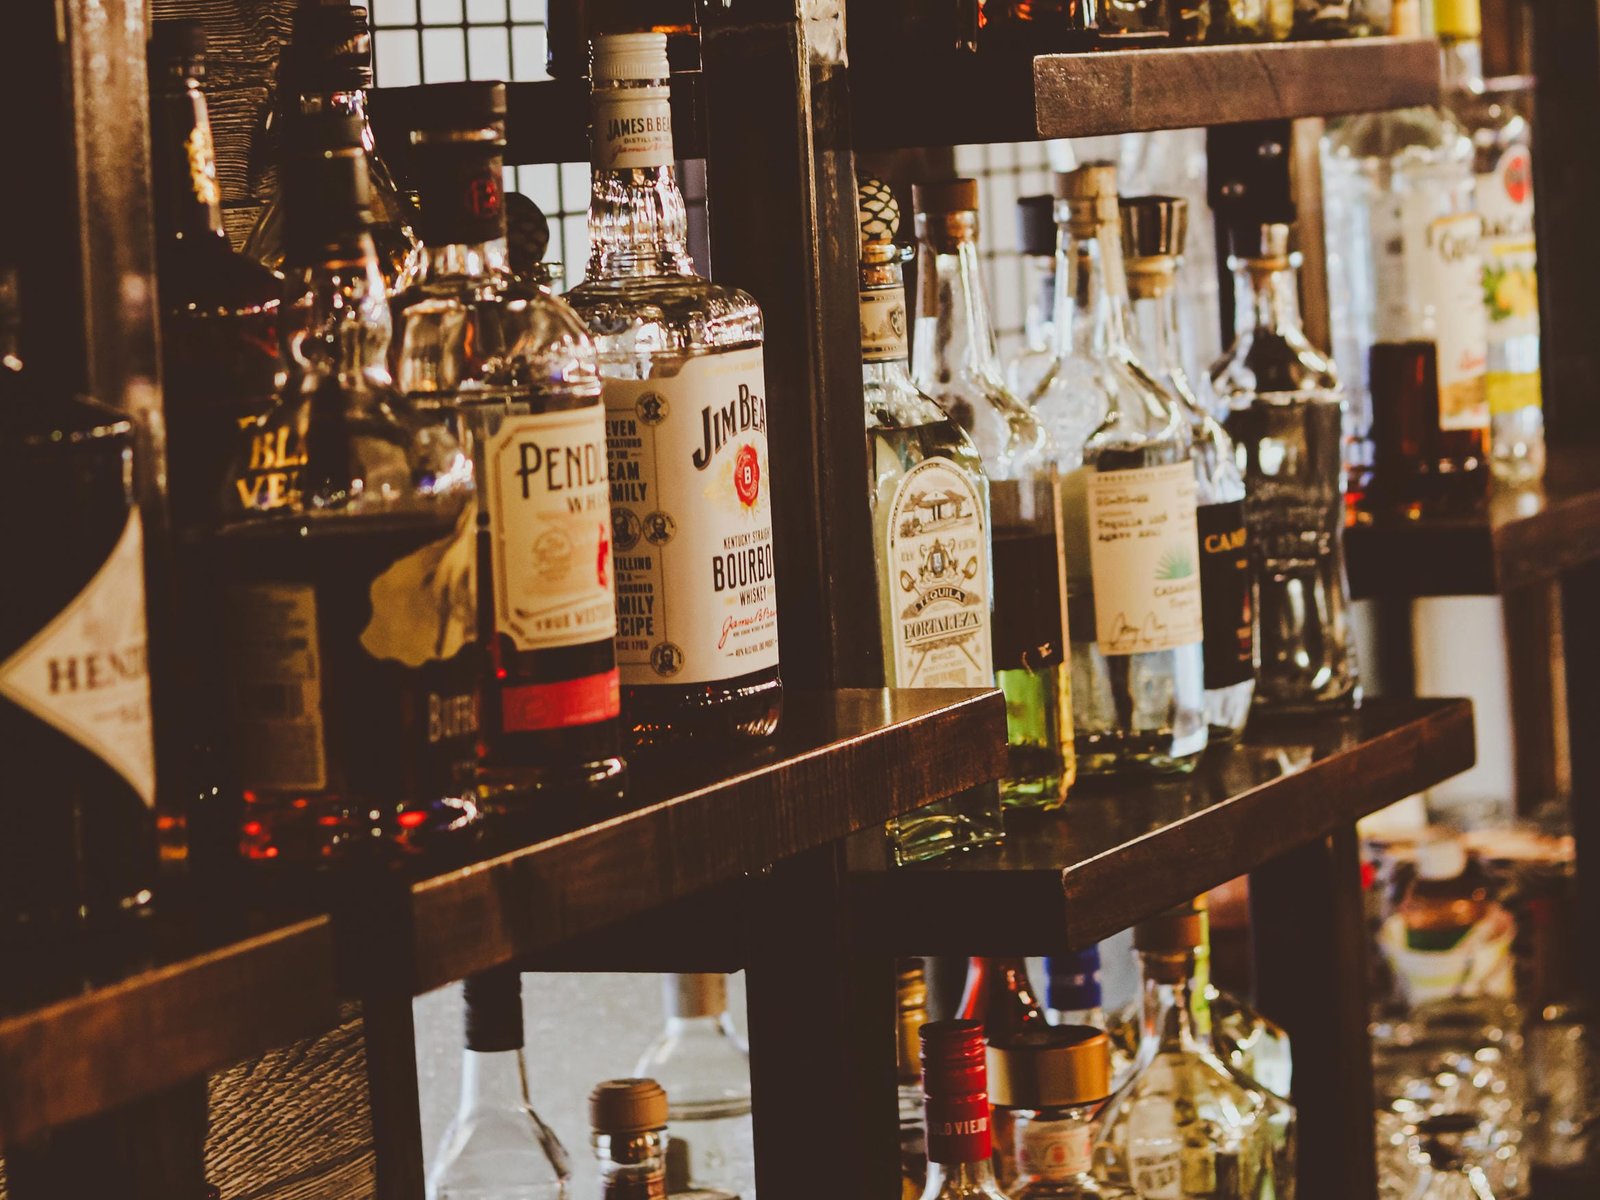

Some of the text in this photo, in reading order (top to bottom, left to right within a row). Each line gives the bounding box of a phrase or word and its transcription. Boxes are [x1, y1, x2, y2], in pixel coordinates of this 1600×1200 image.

[607, 117, 644, 142] JAMES
[692, 396, 736, 470] JIM
[609, 482, 648, 502] MILY
[723, 531, 751, 550] KENTUCKY
[712, 545, 773, 593] BOURBO
[616, 596, 654, 616] MILY
[739, 586, 767, 608] WHISKEY
[917, 587, 964, 610] TEQUILA
